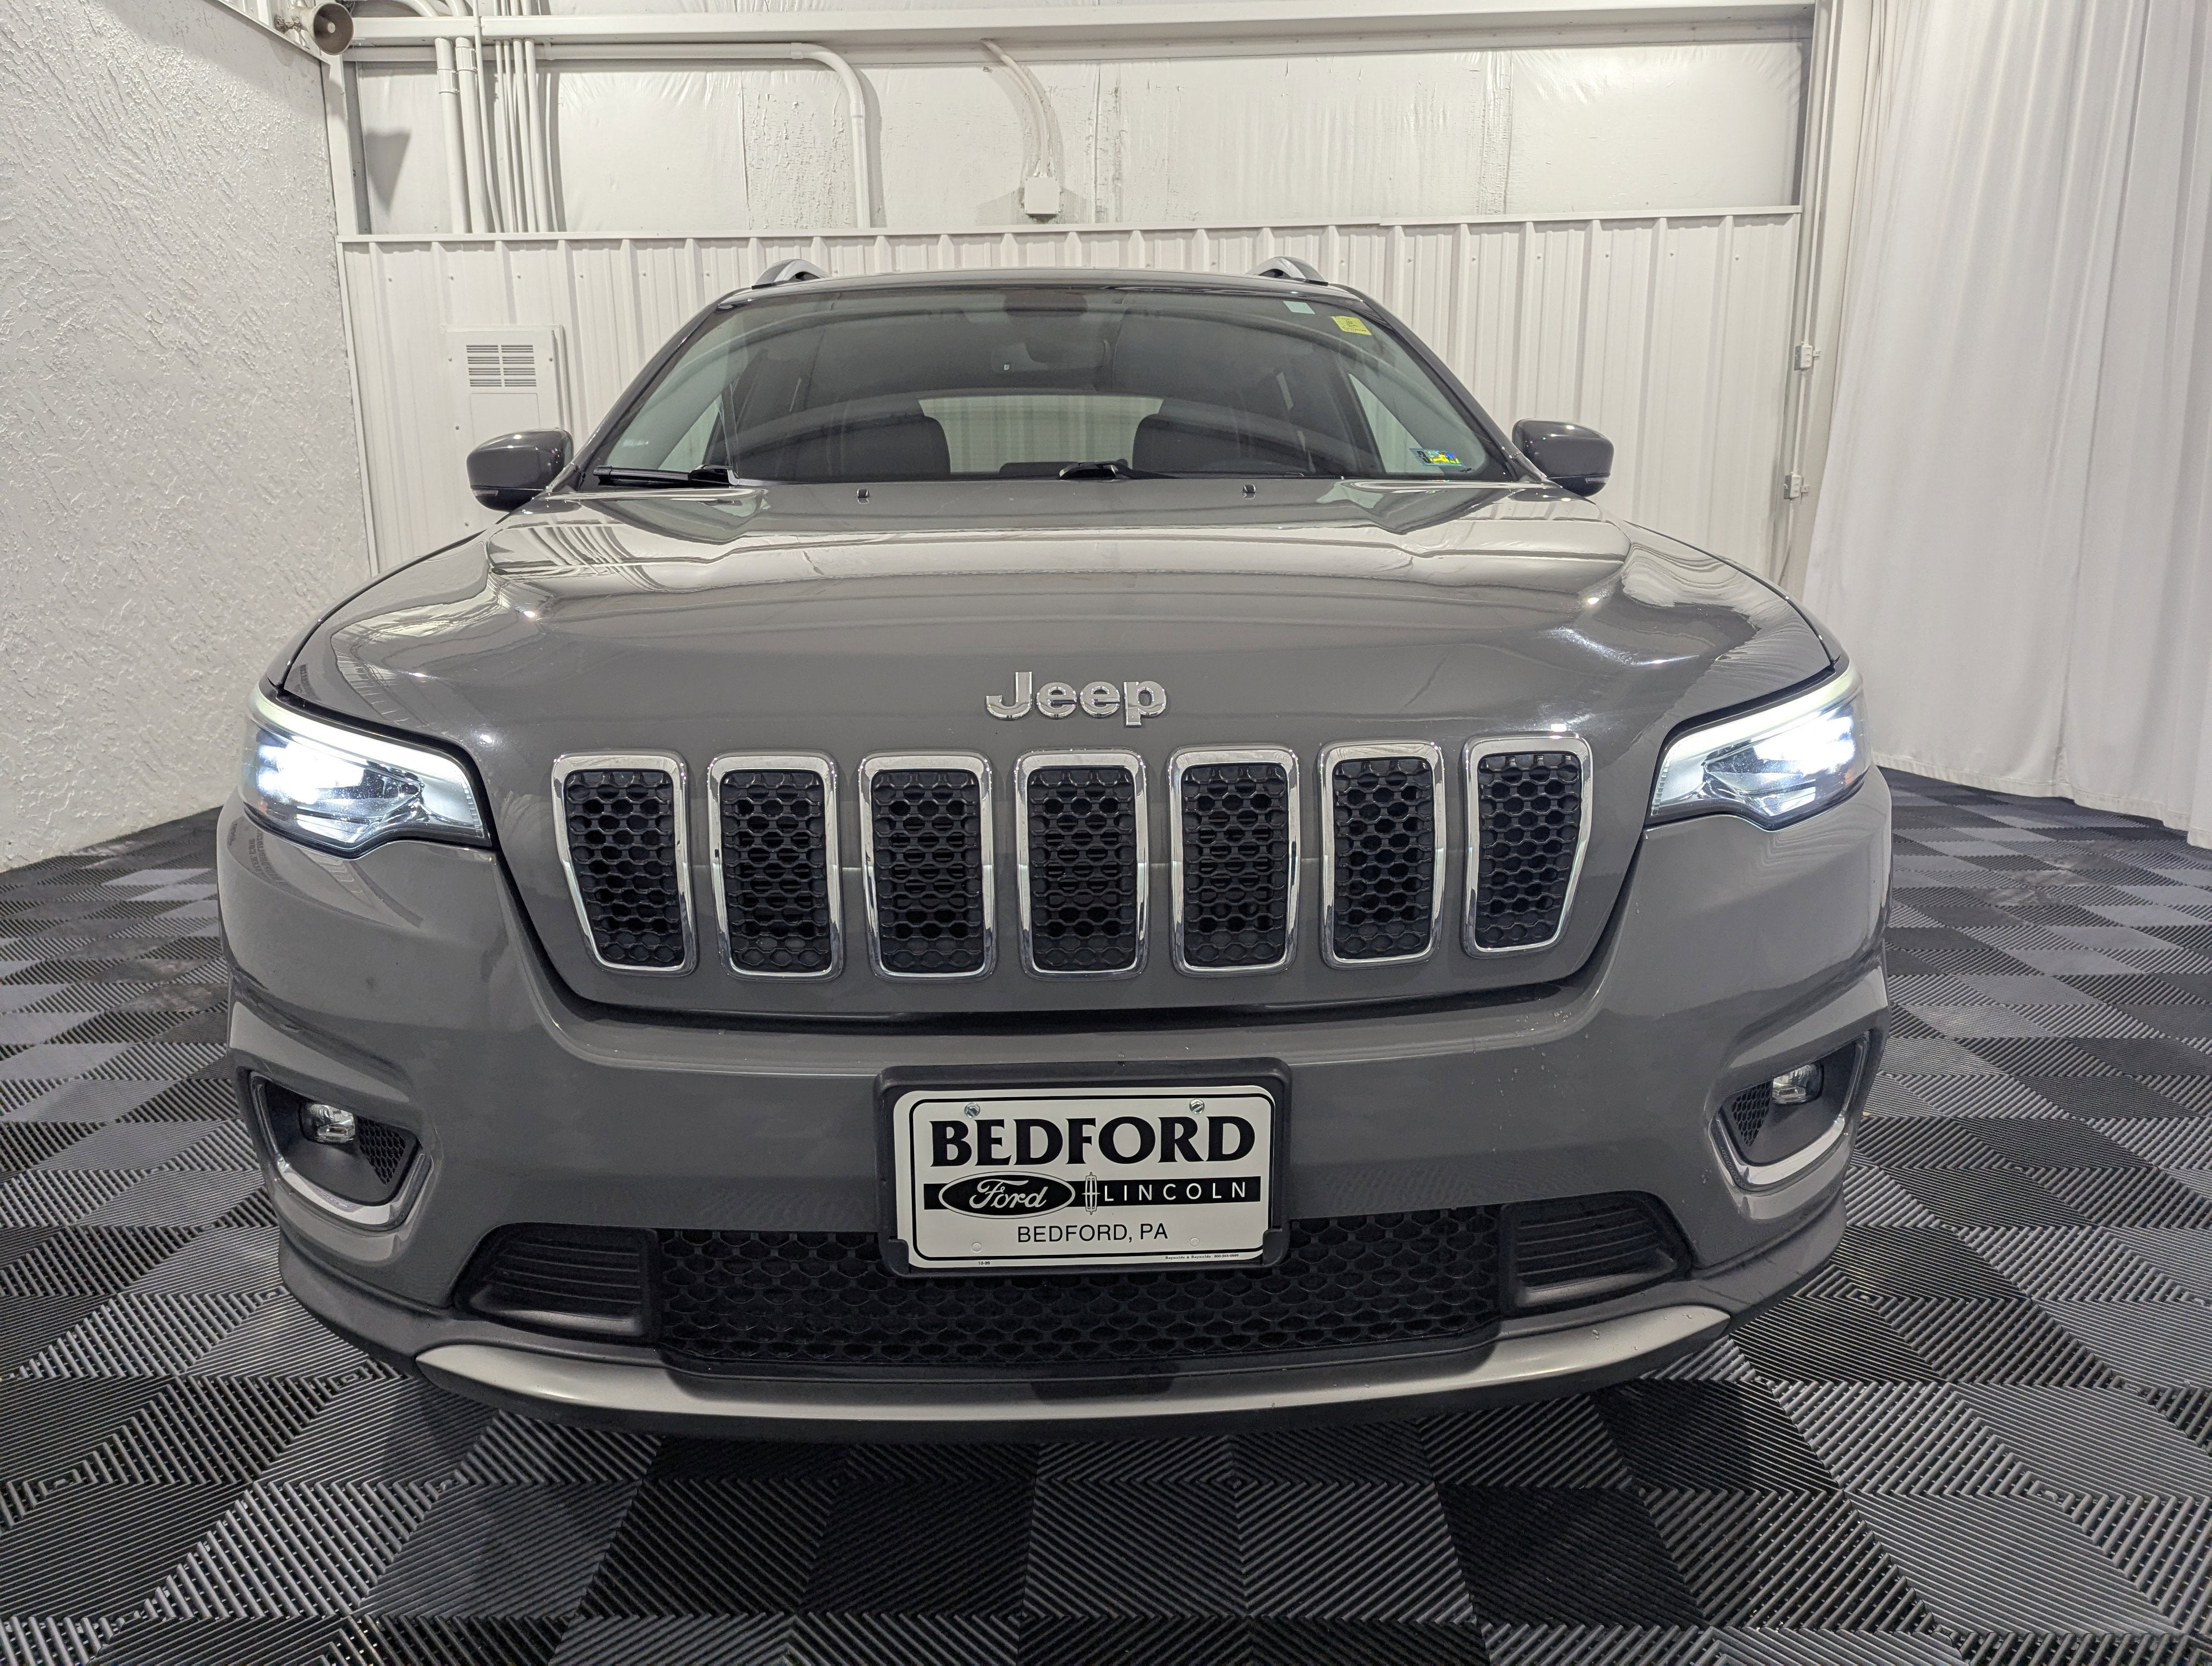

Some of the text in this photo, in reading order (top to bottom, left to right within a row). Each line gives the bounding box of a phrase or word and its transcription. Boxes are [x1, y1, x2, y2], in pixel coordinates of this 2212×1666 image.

[985, 671, 1167, 728] Jeep
[929, 1116, 1256, 1167] BEDFORD
[969, 1178, 1047, 1210] Ford
[1103, 1182, 1246, 1202] LINCOLN
[1017, 1223, 1168, 1244] BEDFORD, PA
